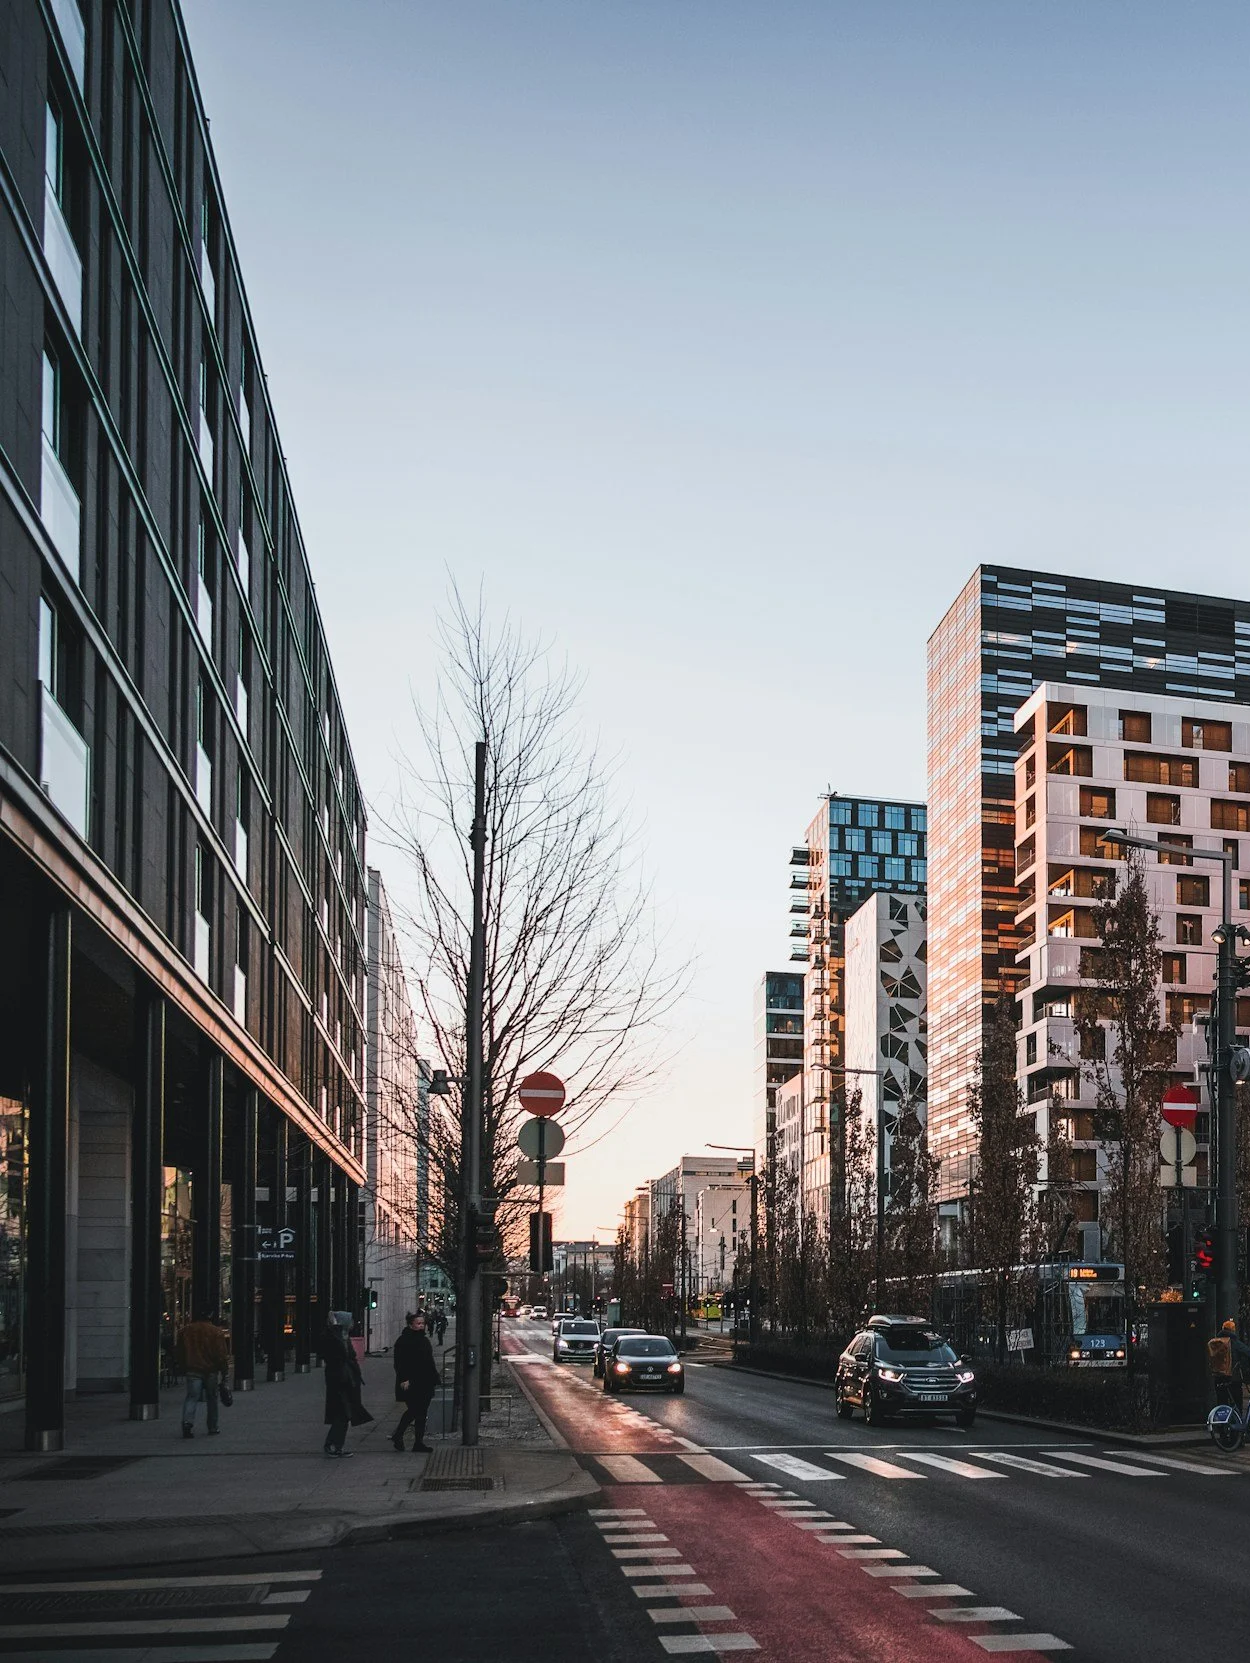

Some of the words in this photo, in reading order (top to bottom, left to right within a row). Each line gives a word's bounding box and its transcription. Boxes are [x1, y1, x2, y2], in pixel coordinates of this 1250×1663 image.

[280, 1232, 294, 1249] P
[1070, 1268, 1078, 1278] 19
[1090, 1339, 1106, 1348] 123
